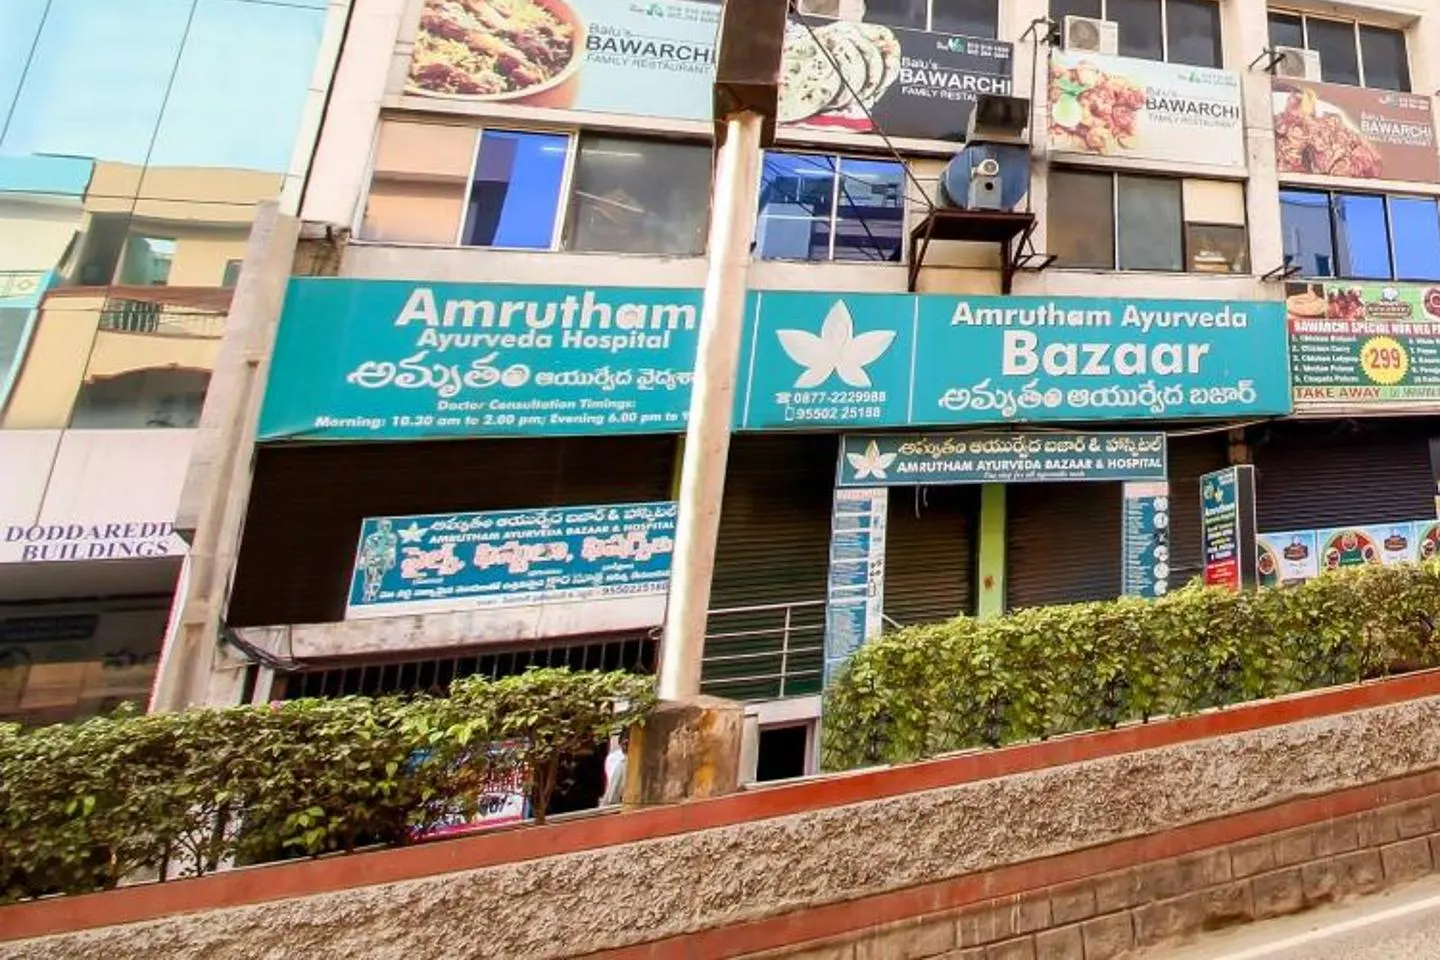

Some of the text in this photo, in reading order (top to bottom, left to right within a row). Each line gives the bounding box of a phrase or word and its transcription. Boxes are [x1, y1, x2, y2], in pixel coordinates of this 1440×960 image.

[587, 53, 712, 75] FAMILY RESTAURANT
[900, 68, 1012, 96] BAWARCHI
[902, 86, 938, 99] FAMILY
[1146, 97, 1239, 120] BAWARCHI
[394, 287, 697, 330] Amrutham
[951, 301, 1248, 333] Amrutham Ayurveda
[1294, 321, 1349, 334] BAWARCHI
[1351, 321, 1391, 334] SPECIAL
[416, 328, 671, 353] Ayurveda Hospital
[1002, 329, 1210, 376] Bazaar
[346, 350, 531, 398] అమృతం
[938, 378, 1257, 418] అమృతం ఆయుర్వేద బజార్
[1296, 387, 1335, 399] TAKE
[1339, 387, 1381, 398] AWAY
[437, 400, 484, 411] Doctor
[489, 399, 576, 411] Consultation
[315, 415, 387, 430] Morning:
[437, 417, 461, 426] am
[464, 415, 478, 426] to
[550, 413, 605, 426] Evening
[640, 414, 662, 426] pm
[665, 411, 678, 421] to
[1088, 437, 1102, 453] &
[896, 457, 1163, 474] AMRUTHAM AYURVEDA BAZAAR & HOSPITAL
[608, 508, 620, 521] &
[429, 532, 500, 545] AMRUTHAM
[503, 527, 563, 540] AYURVEDA
[566, 524, 610, 537] BAZAAR
[623, 520, 676, 533] HOSPITAL
[20, 540, 169, 561] BUILDINGS
